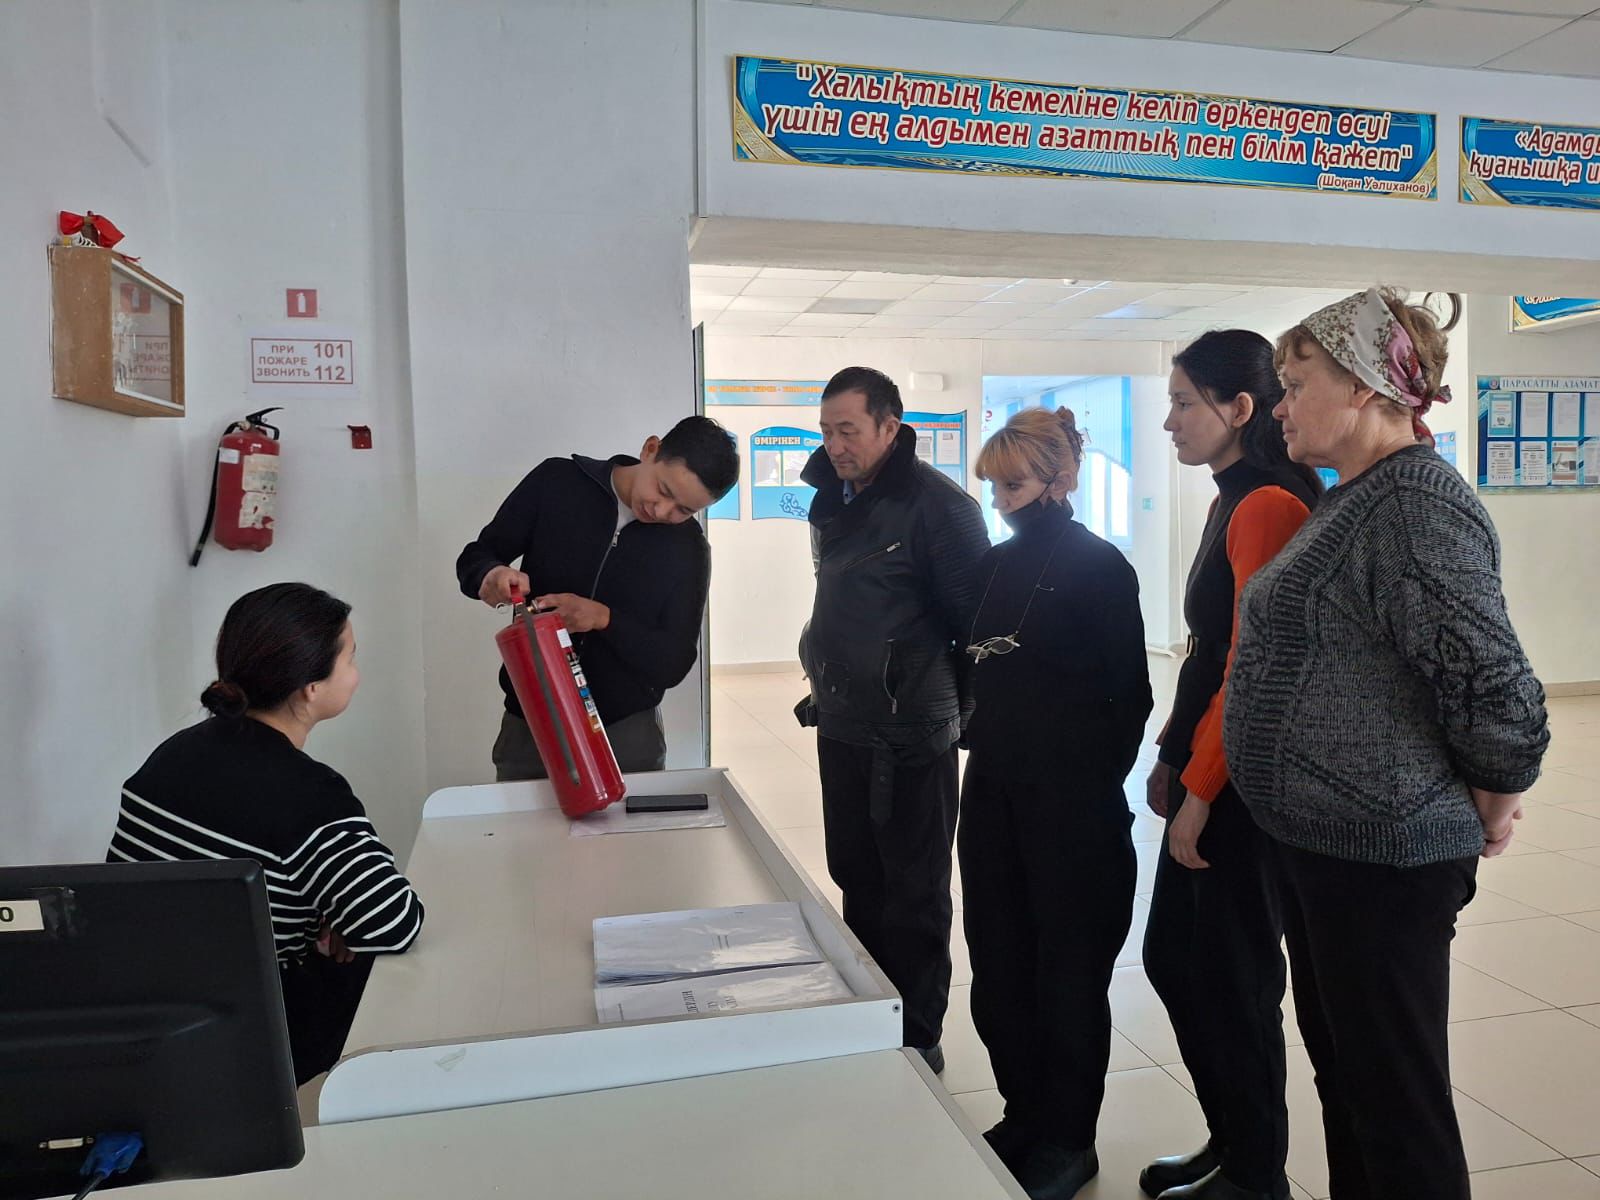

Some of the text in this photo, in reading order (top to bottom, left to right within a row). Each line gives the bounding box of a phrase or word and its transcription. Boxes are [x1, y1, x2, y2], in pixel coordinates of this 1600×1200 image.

[798, 64, 1391, 141] "Халықтың кемеліне келіп өркендеп өсуі
[762, 104, 1413, 170] үшін ең алдымен азаттық пен білім қажет"
[1469, 150, 1581, 185] қуанышқа
[1318, 175, 1430, 196] (Шоқан Уәлиханов)
[271, 345, 294, 353] ПРИ
[313, 343, 344, 358] 101
[258, 356, 308, 365] ПОЖАРЕ
[256, 367, 310, 377] ЗВОНИТЬ
[314, 365, 345, 380] 112
